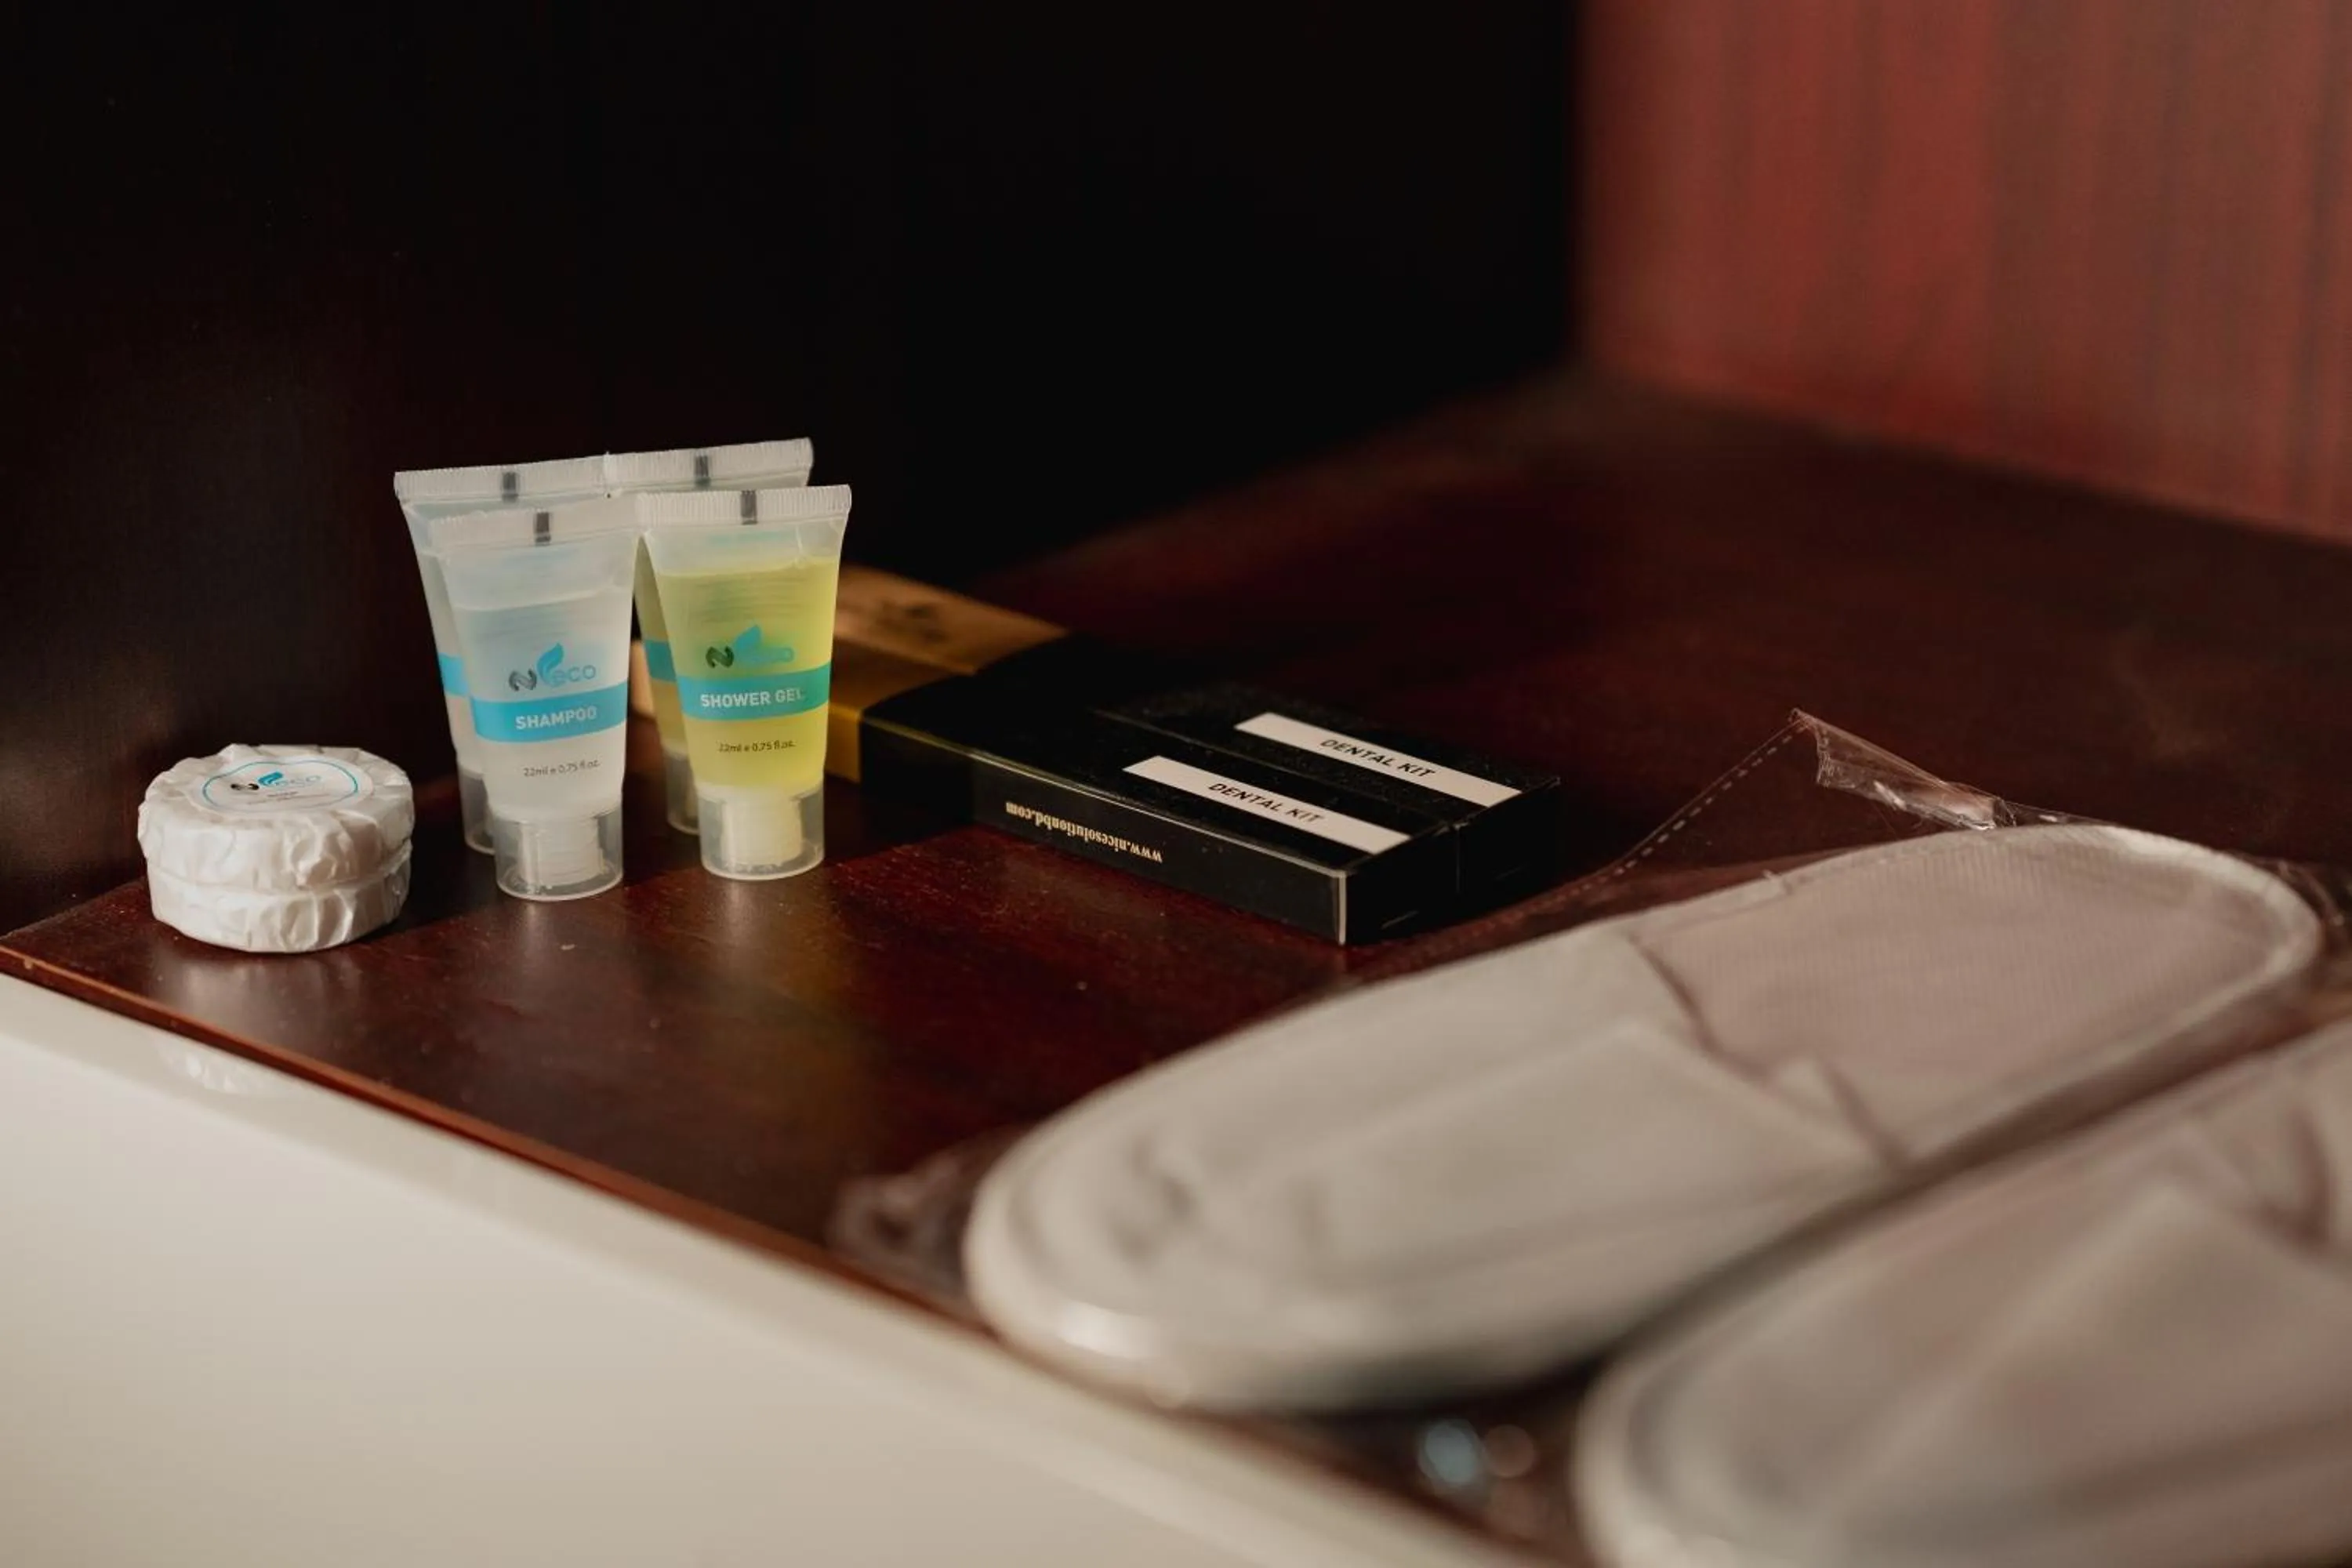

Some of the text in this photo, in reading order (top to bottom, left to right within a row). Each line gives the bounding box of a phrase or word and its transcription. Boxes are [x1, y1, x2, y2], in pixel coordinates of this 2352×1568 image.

[515, 706, 597, 730] SHAMPOO
[700, 688, 804, 709] SHOWER GEL
[1319, 739, 1438, 778] DENTAL KIT
[1208, 782, 1327, 824] DENTAL KIT
[1005, 800, 1163, 863] www.nicesolutionbd.com
